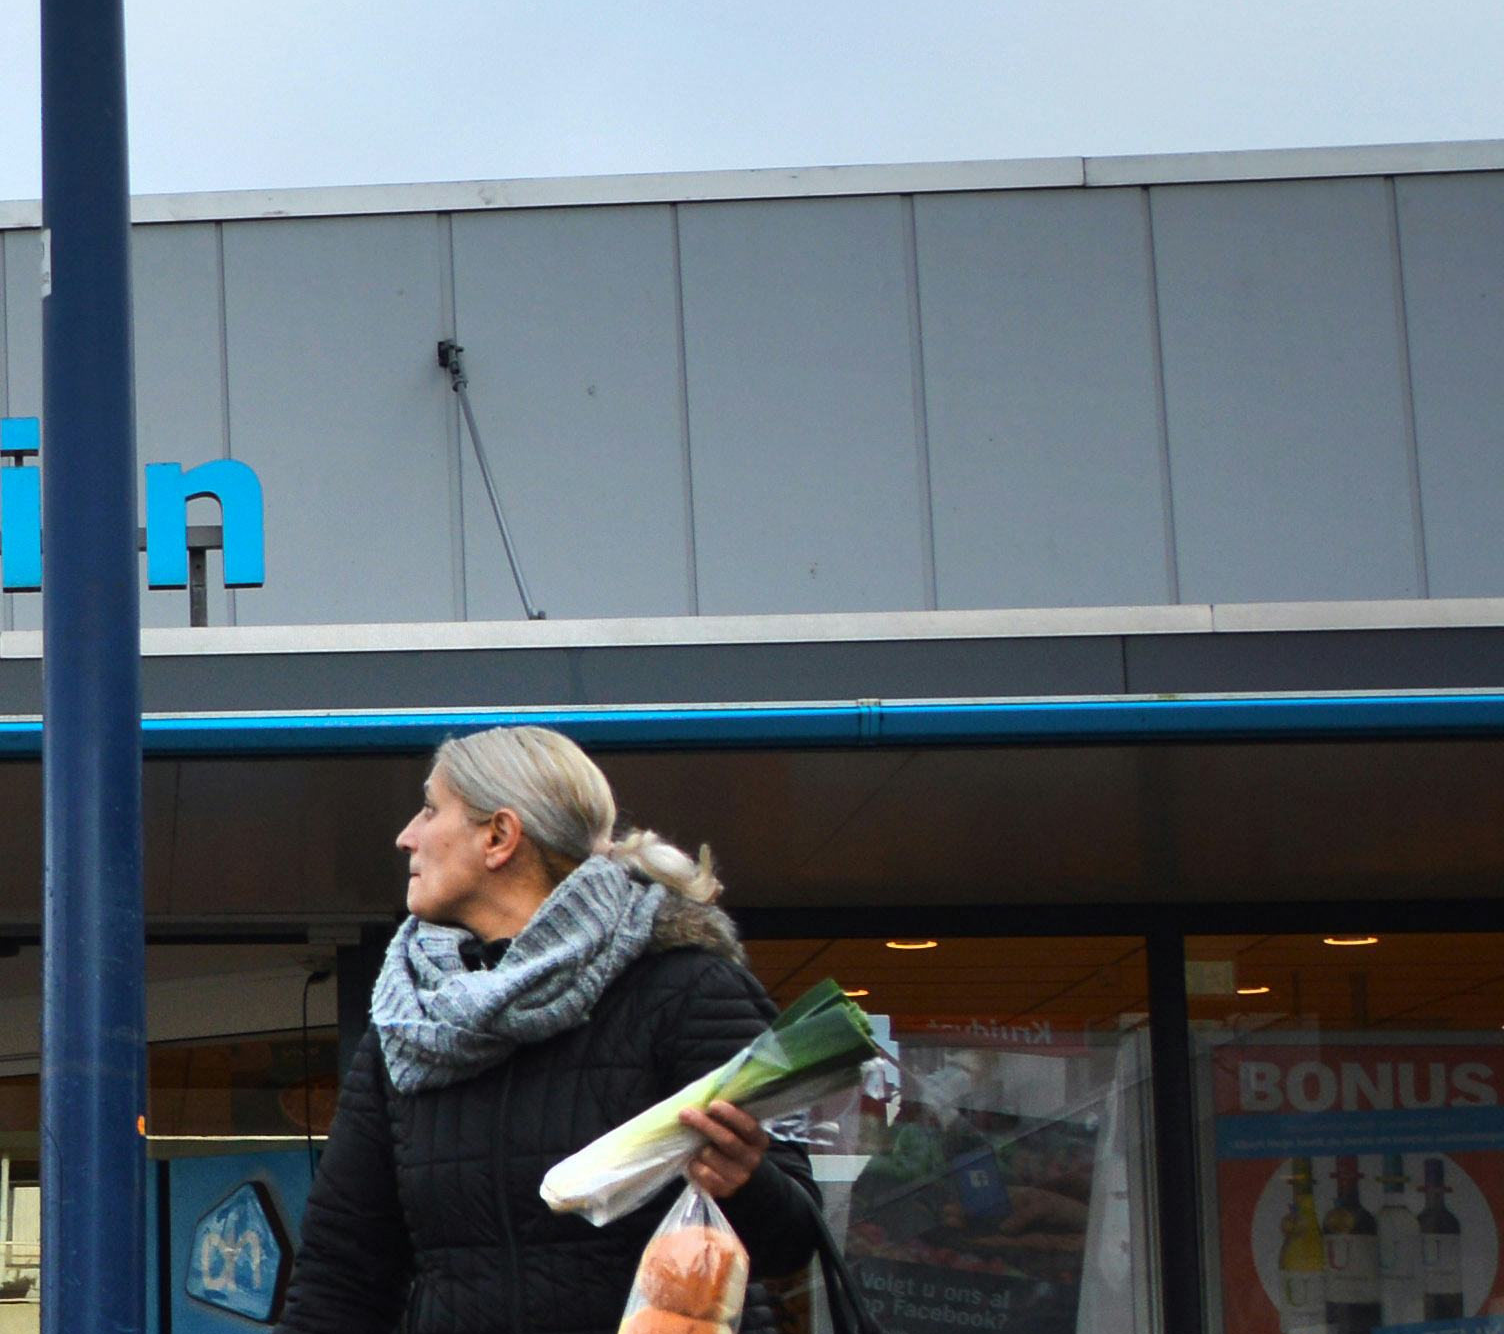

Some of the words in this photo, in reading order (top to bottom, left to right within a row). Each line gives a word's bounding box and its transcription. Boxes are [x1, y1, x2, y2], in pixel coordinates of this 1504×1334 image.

[1238, 1060, 1499, 1112] BONUS
[893, 1298, 1009, 1331] Facebook?
[944, 1285, 982, 1306] ons
[990, 1289, 1009, 1311] al
